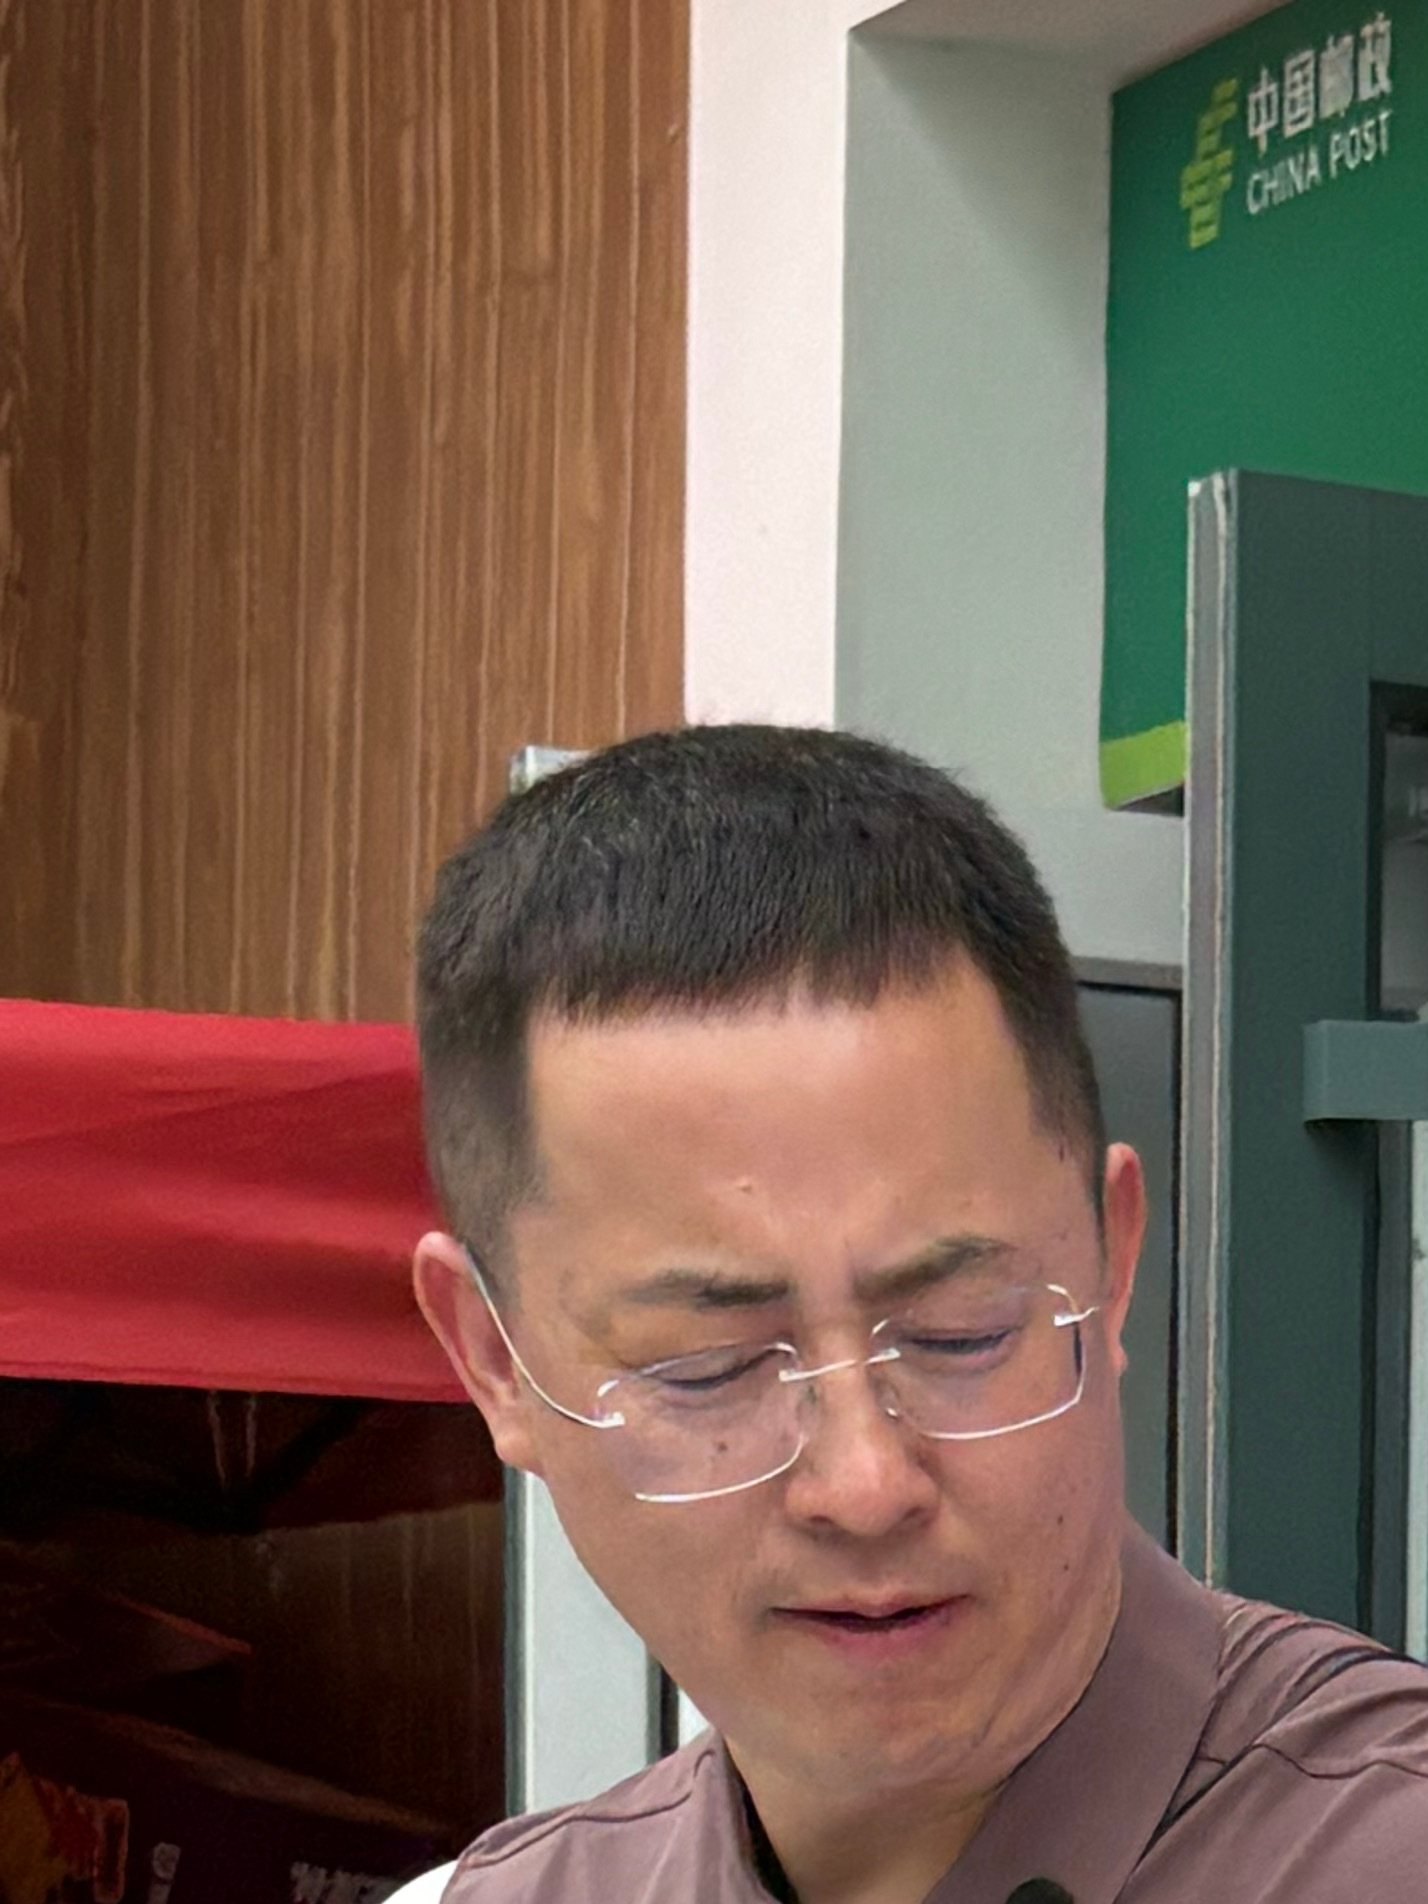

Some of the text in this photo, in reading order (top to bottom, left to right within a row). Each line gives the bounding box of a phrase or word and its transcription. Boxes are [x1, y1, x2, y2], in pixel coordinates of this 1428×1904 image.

[1247, 11, 1392, 159] 中国邮政
[1247, 109, 1393, 215] CHINA POST
